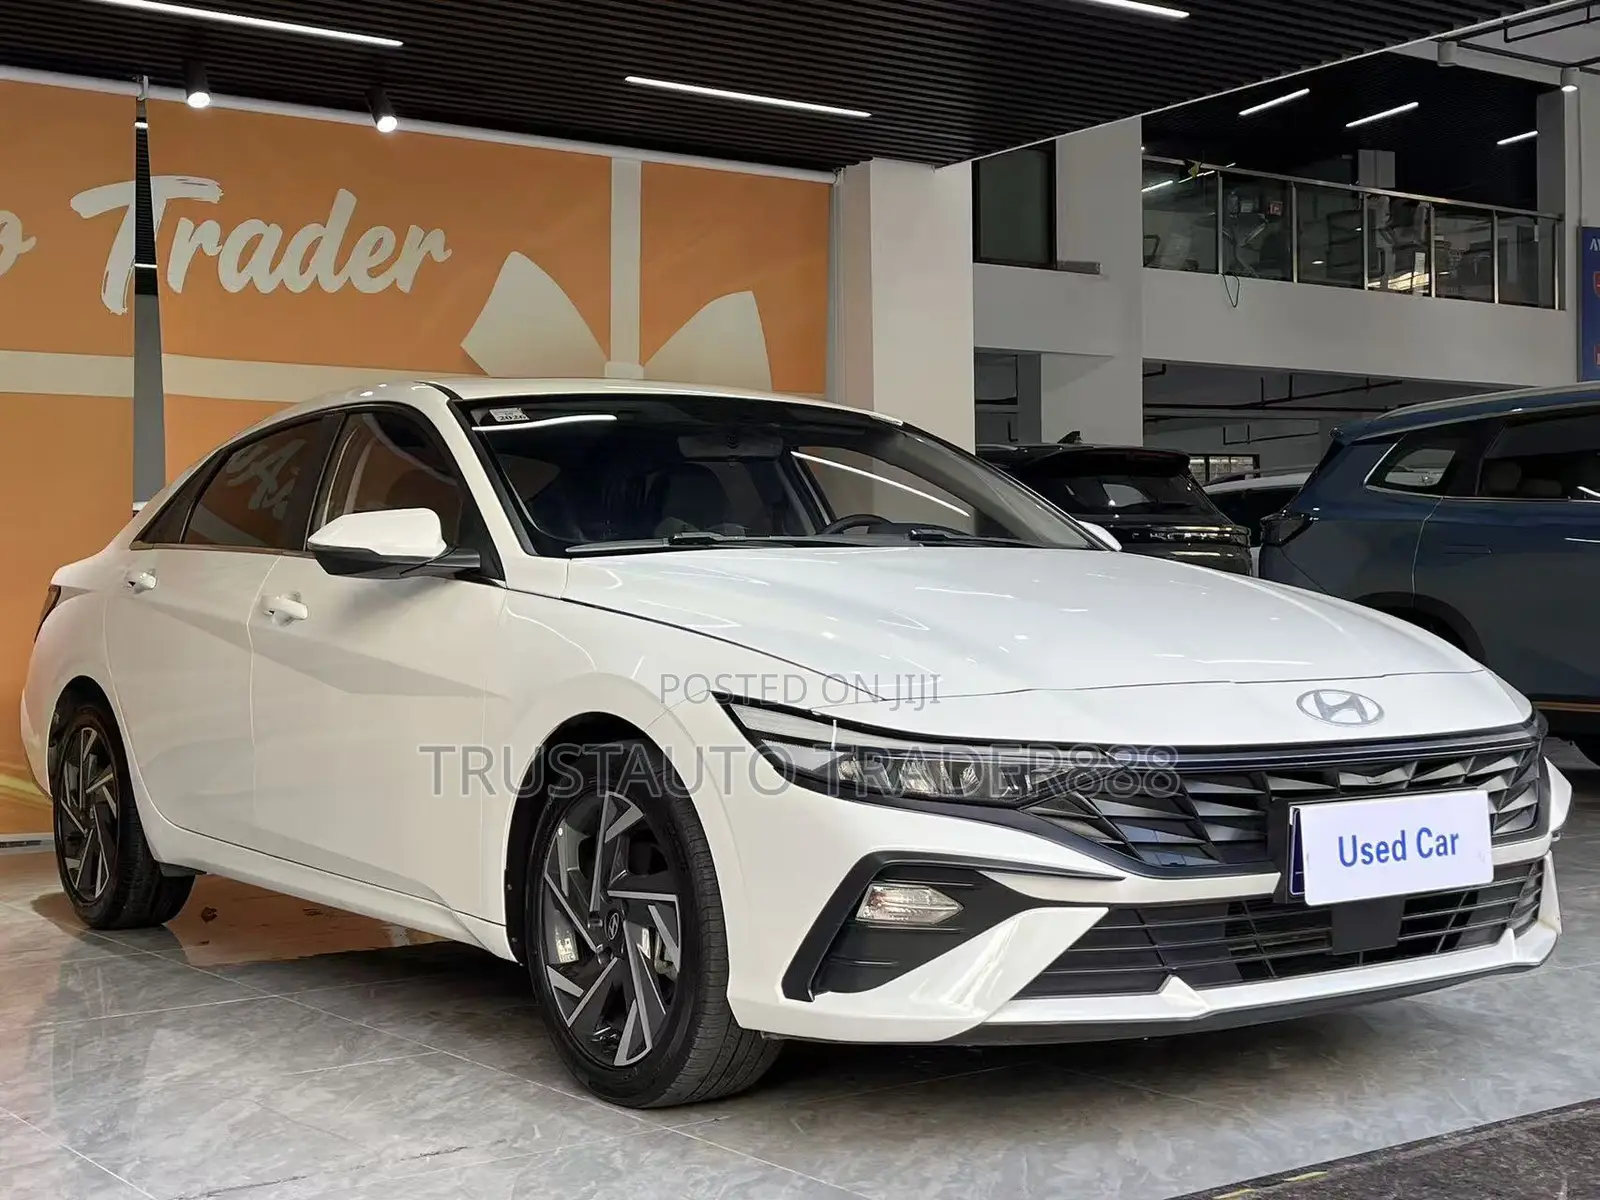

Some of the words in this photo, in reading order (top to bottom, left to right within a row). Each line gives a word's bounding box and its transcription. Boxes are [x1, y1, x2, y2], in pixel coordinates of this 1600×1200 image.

[70, 174, 453, 315] Trader
[1337, 829, 1407, 868] Used
[1416, 826, 1459, 859] Car
